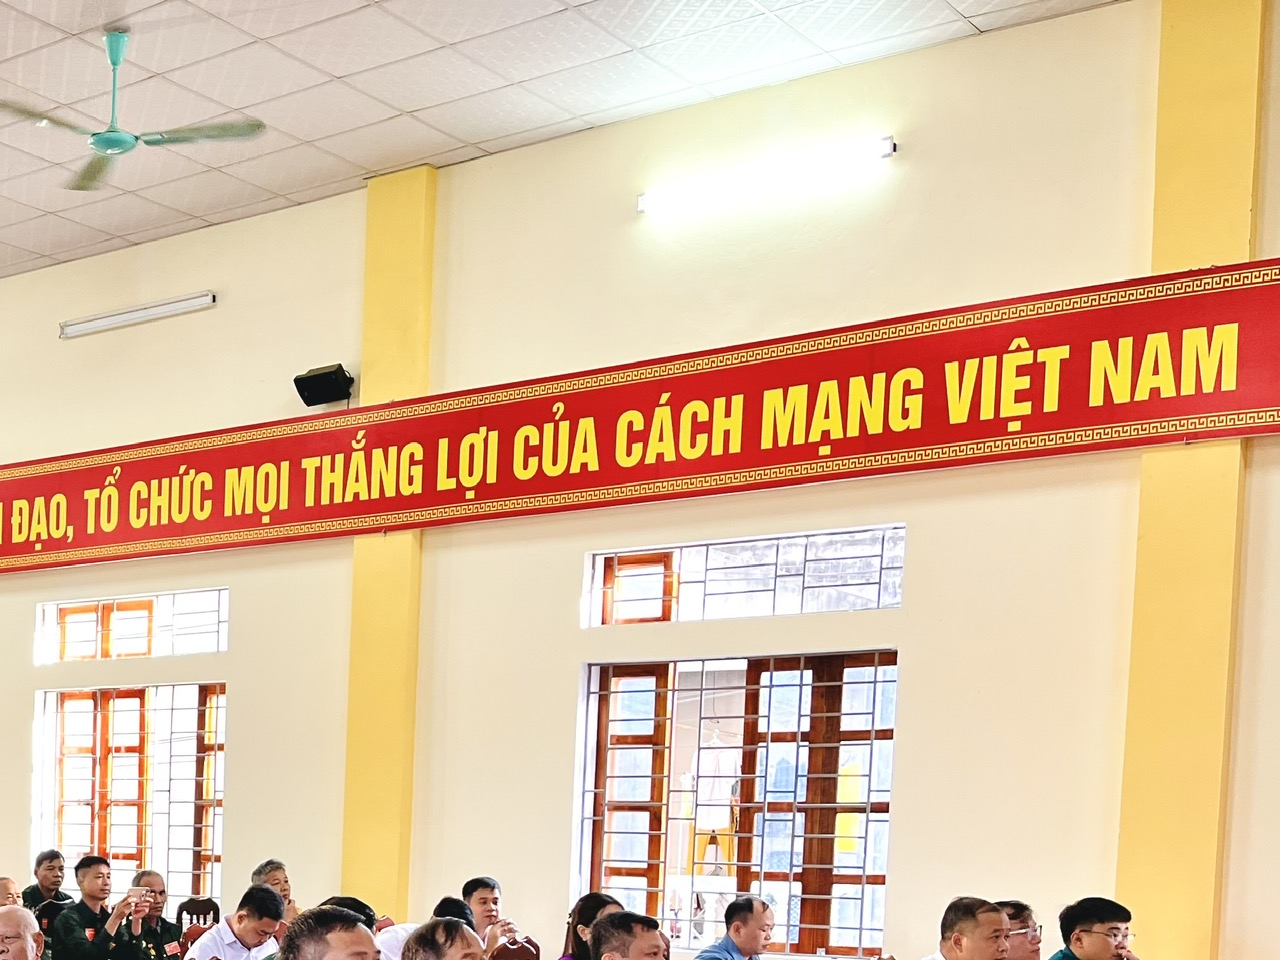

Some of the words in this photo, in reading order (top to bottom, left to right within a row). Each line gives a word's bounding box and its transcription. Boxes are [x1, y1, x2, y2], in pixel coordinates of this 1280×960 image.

[11, 493, 74, 551] ĐẠO,
[84, 466, 122, 534] TỔ
[129, 465, 213, 528] CHỨC
[224, 461, 290, 523] MỌI
[301, 430, 424, 507] THẮNG
[437, 426, 499, 491] LỢI
[514, 402, 600, 480] CỦA
[615, 392, 744, 468] CÁCH
[760, 367, 924, 457] MẠNG
[945, 337, 1070, 431] VIỆT
[1089, 323, 1239, 407] NAM
